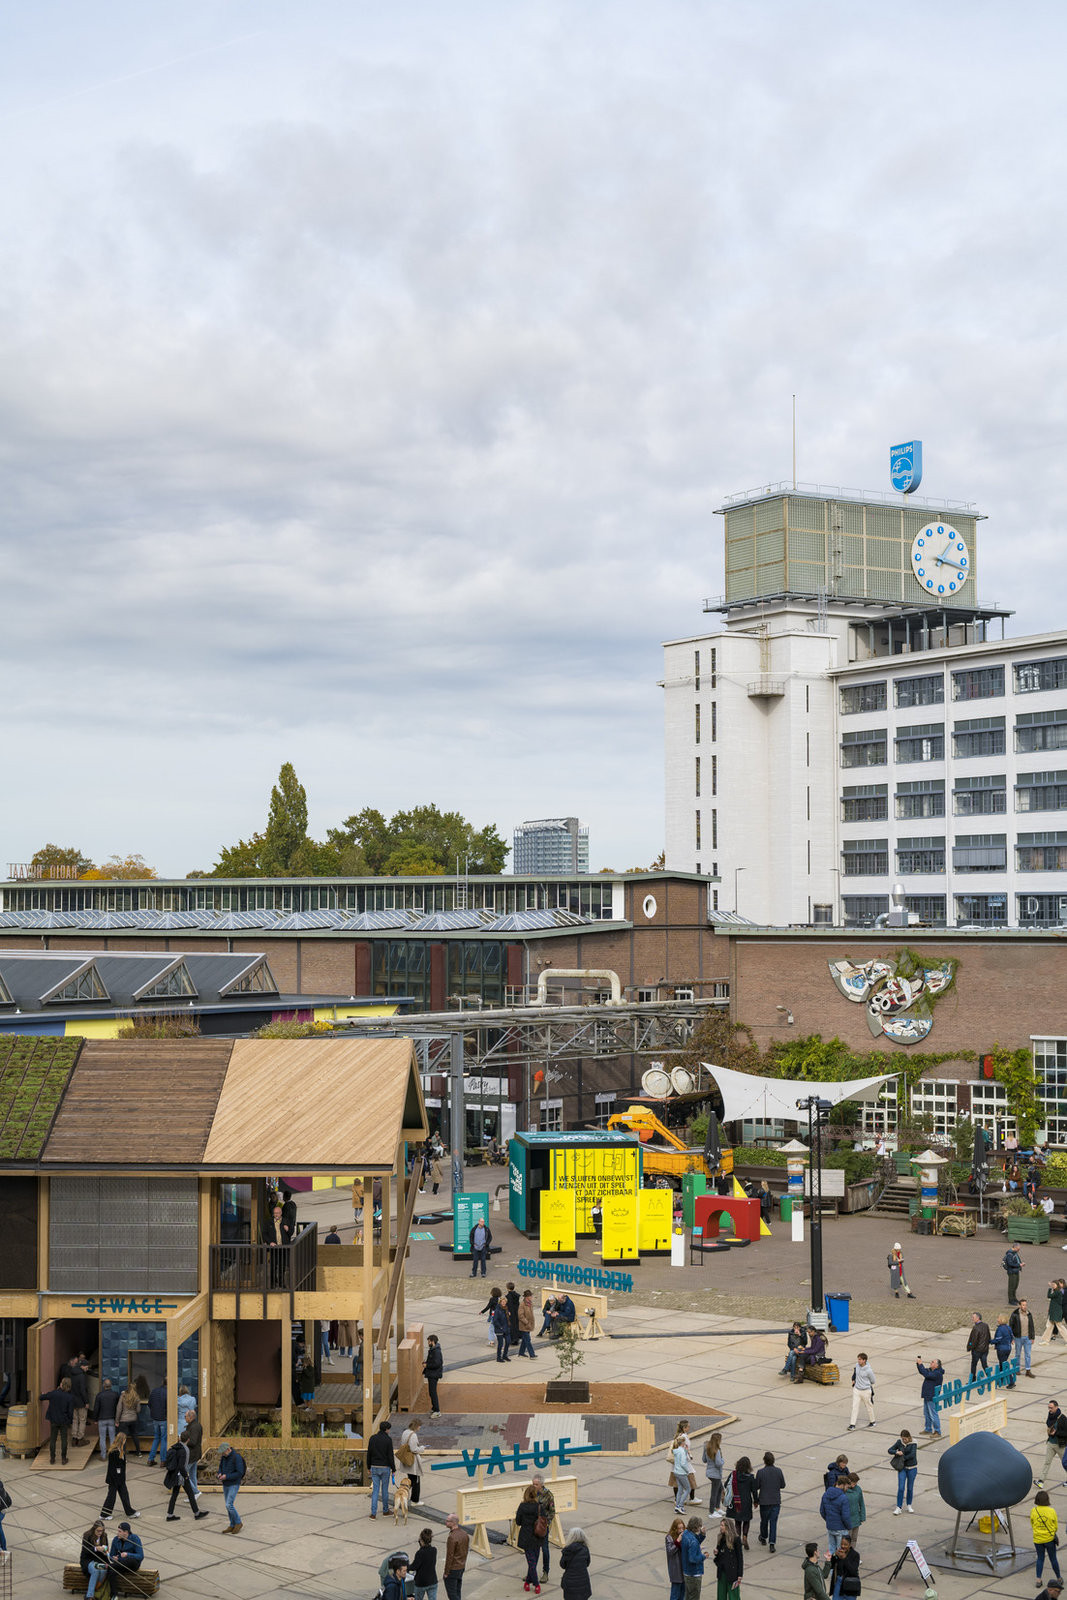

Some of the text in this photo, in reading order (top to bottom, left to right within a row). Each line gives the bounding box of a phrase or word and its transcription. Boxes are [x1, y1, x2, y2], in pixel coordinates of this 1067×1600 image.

[891, 444, 913, 457] PHILIPS
[86, 1298, 162, 1313] SEWAGE
[933, 1378, 962, 1412] END
[462, 1437, 571, 1477] VALUE
